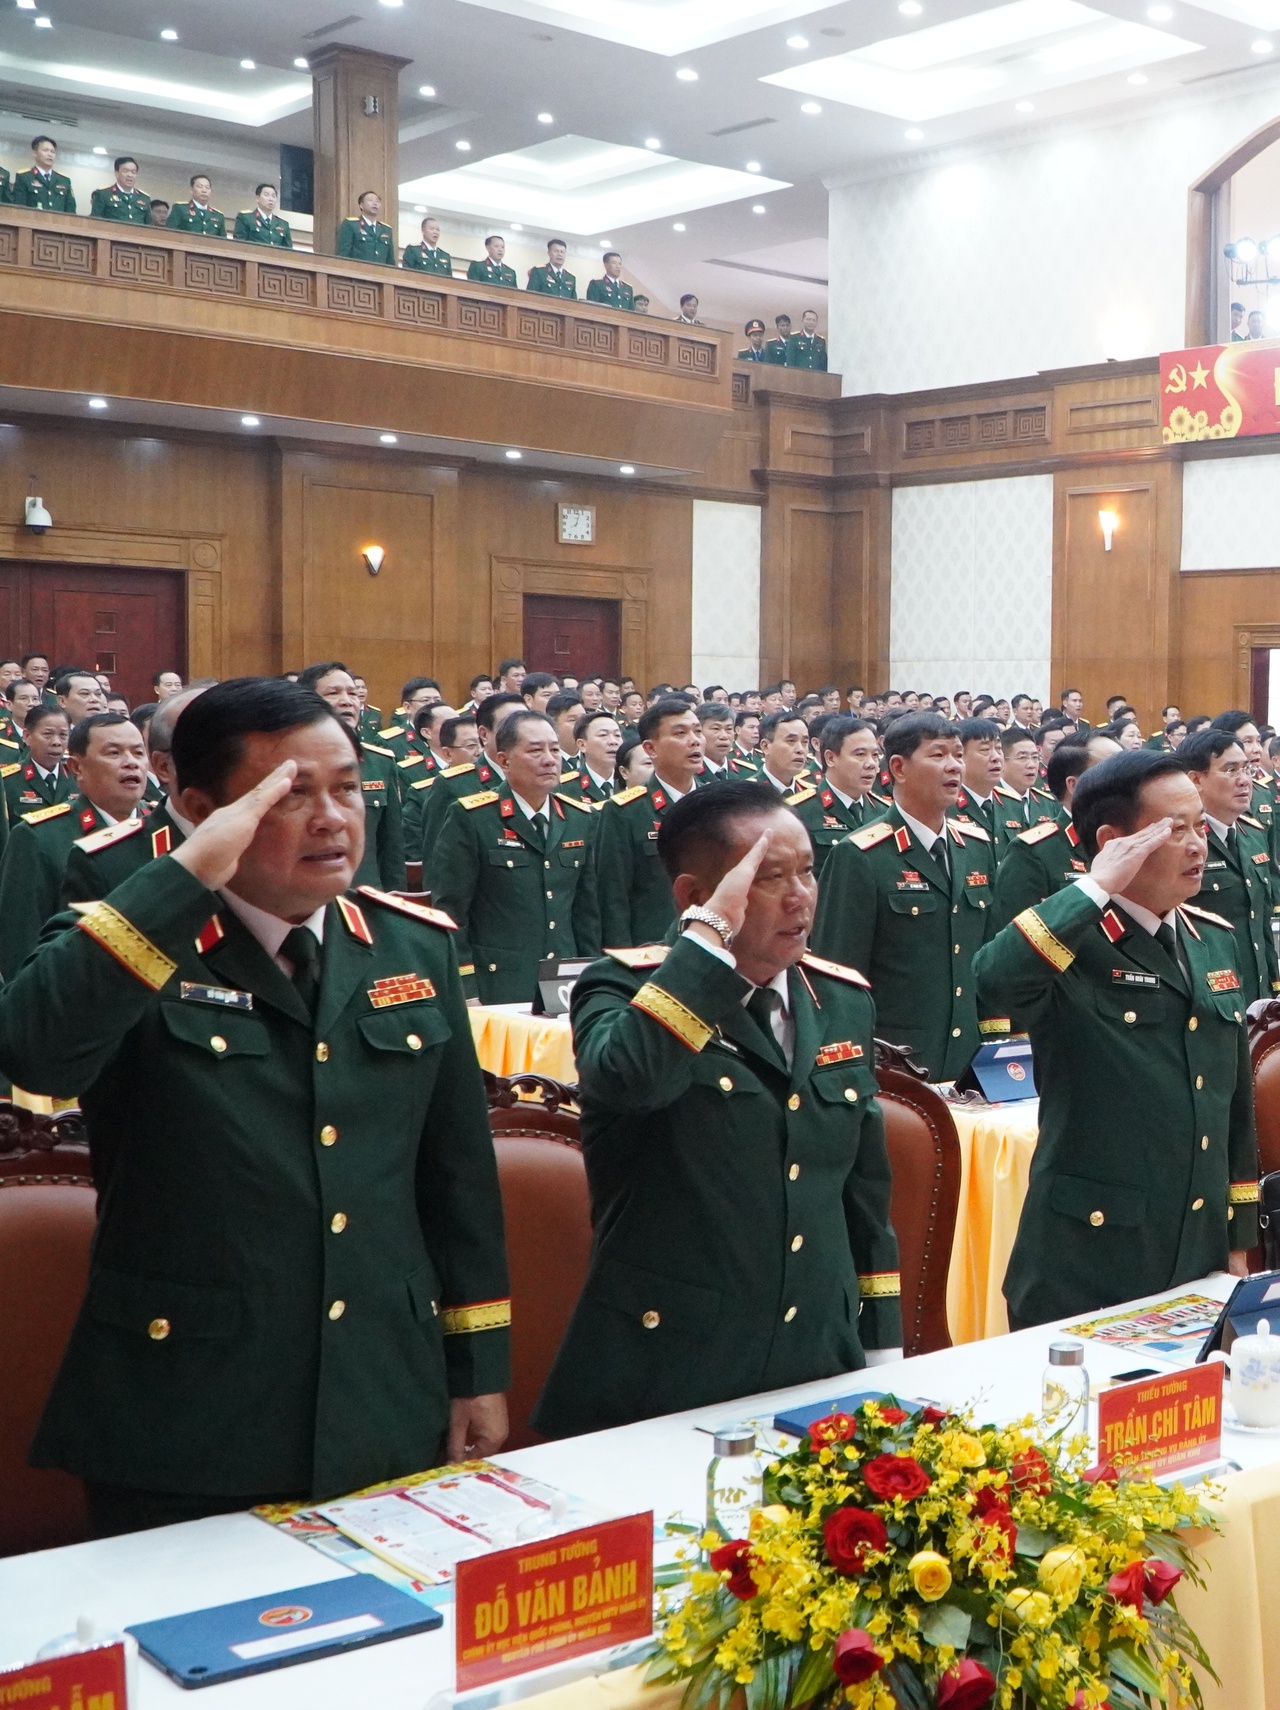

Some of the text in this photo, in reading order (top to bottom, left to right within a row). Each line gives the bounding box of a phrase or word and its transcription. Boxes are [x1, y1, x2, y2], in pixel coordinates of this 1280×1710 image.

[1137, 1380, 1188, 1403] THIẾU TƯỚNG
[1104, 1394, 1216, 1454] TRẦN CHÍ TÂM
[518, 1538, 598, 1574] TRUNG TƯỚNG
[475, 1556, 637, 1640] ĐỖ VĂN BẢNH
